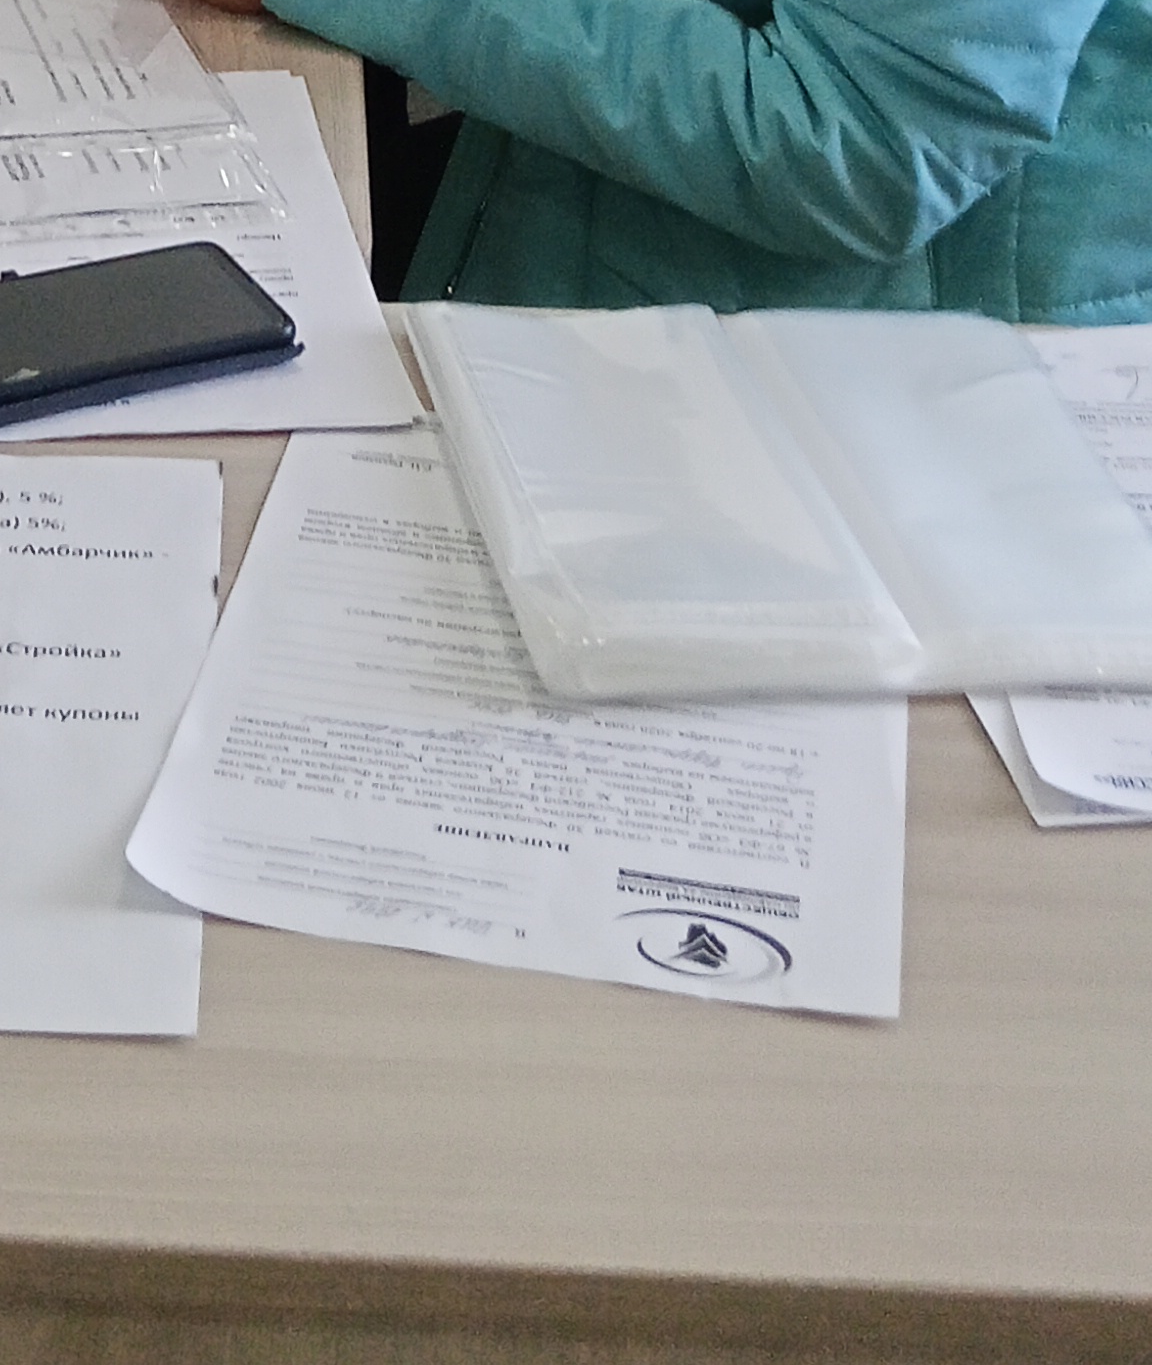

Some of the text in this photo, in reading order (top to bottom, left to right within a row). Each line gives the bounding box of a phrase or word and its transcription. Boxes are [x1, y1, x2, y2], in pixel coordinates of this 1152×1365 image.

[19, 491, 31, 504] 5
[8, 543, 154, 561] «Амбарчик»
[44, 707, 140, 723] купоны
